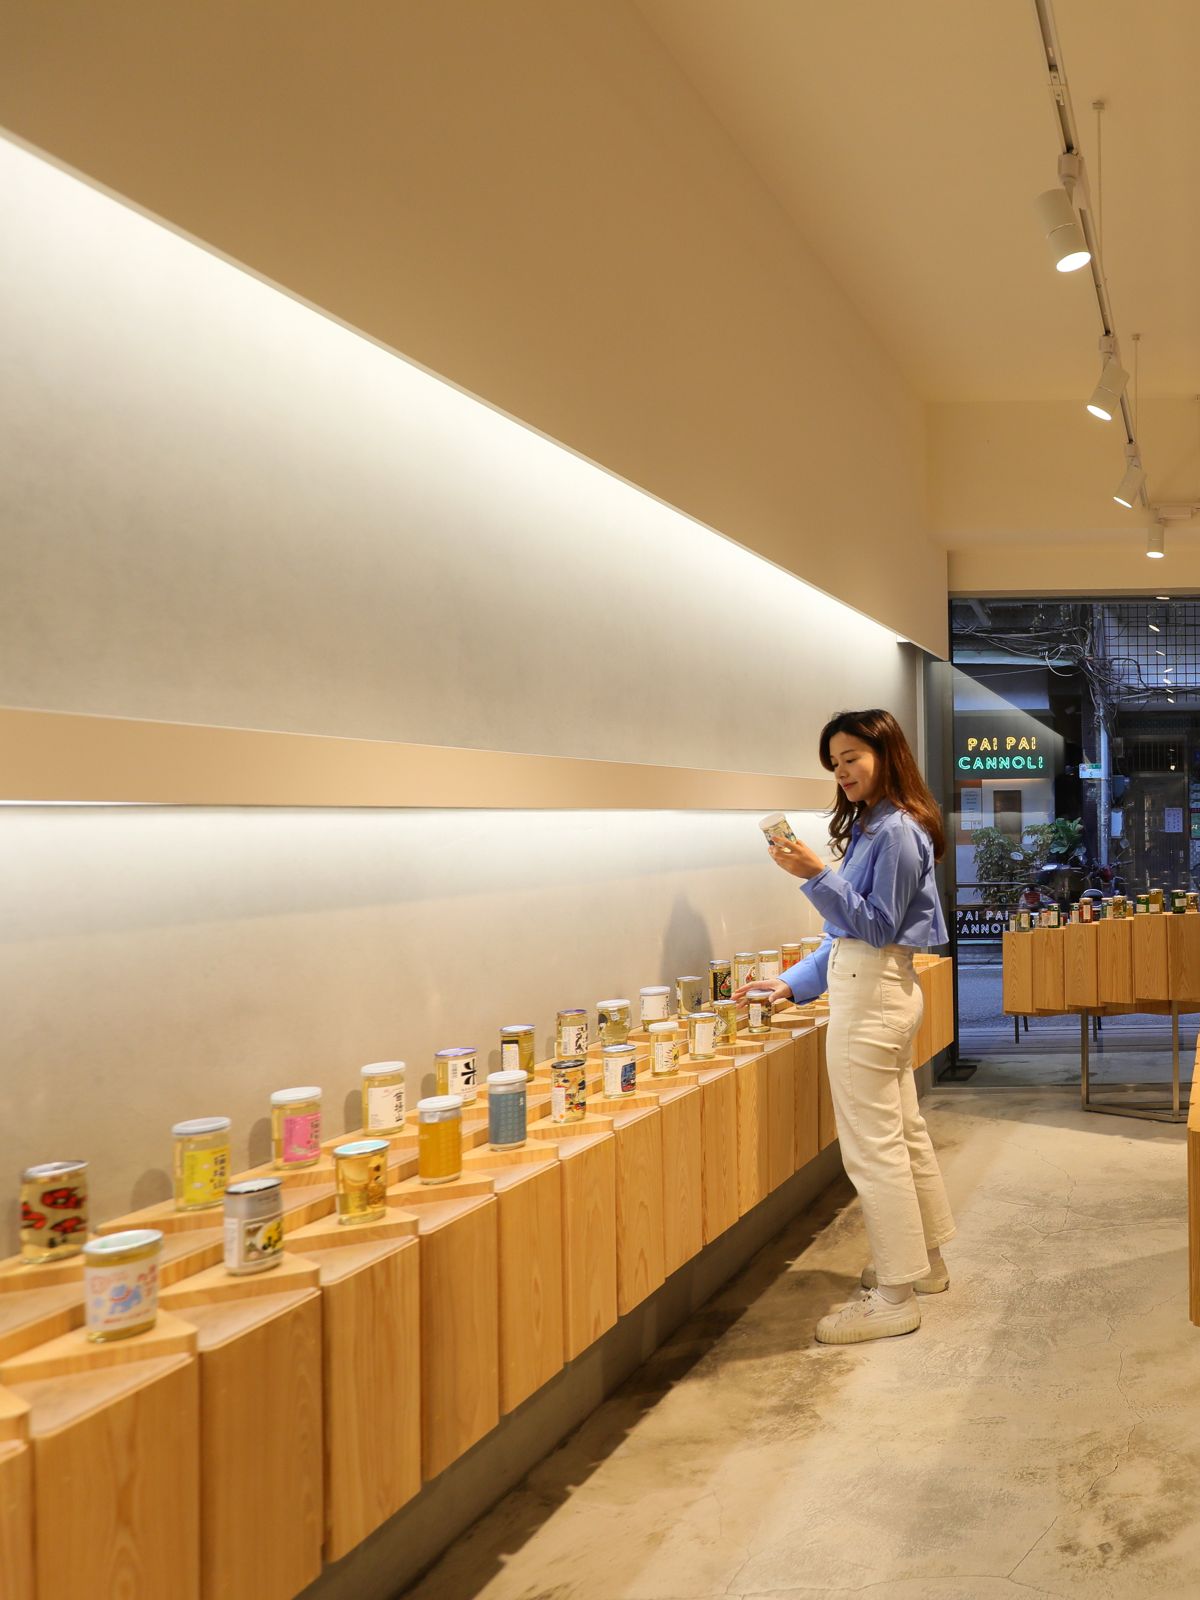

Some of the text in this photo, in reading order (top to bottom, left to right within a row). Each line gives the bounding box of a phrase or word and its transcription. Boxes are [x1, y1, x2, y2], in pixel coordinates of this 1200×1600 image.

[967, 736, 1036, 751] PAI PAI
[958, 756, 1044, 770] CANNOLI
[956, 910, 1009, 921] PAI PAI
